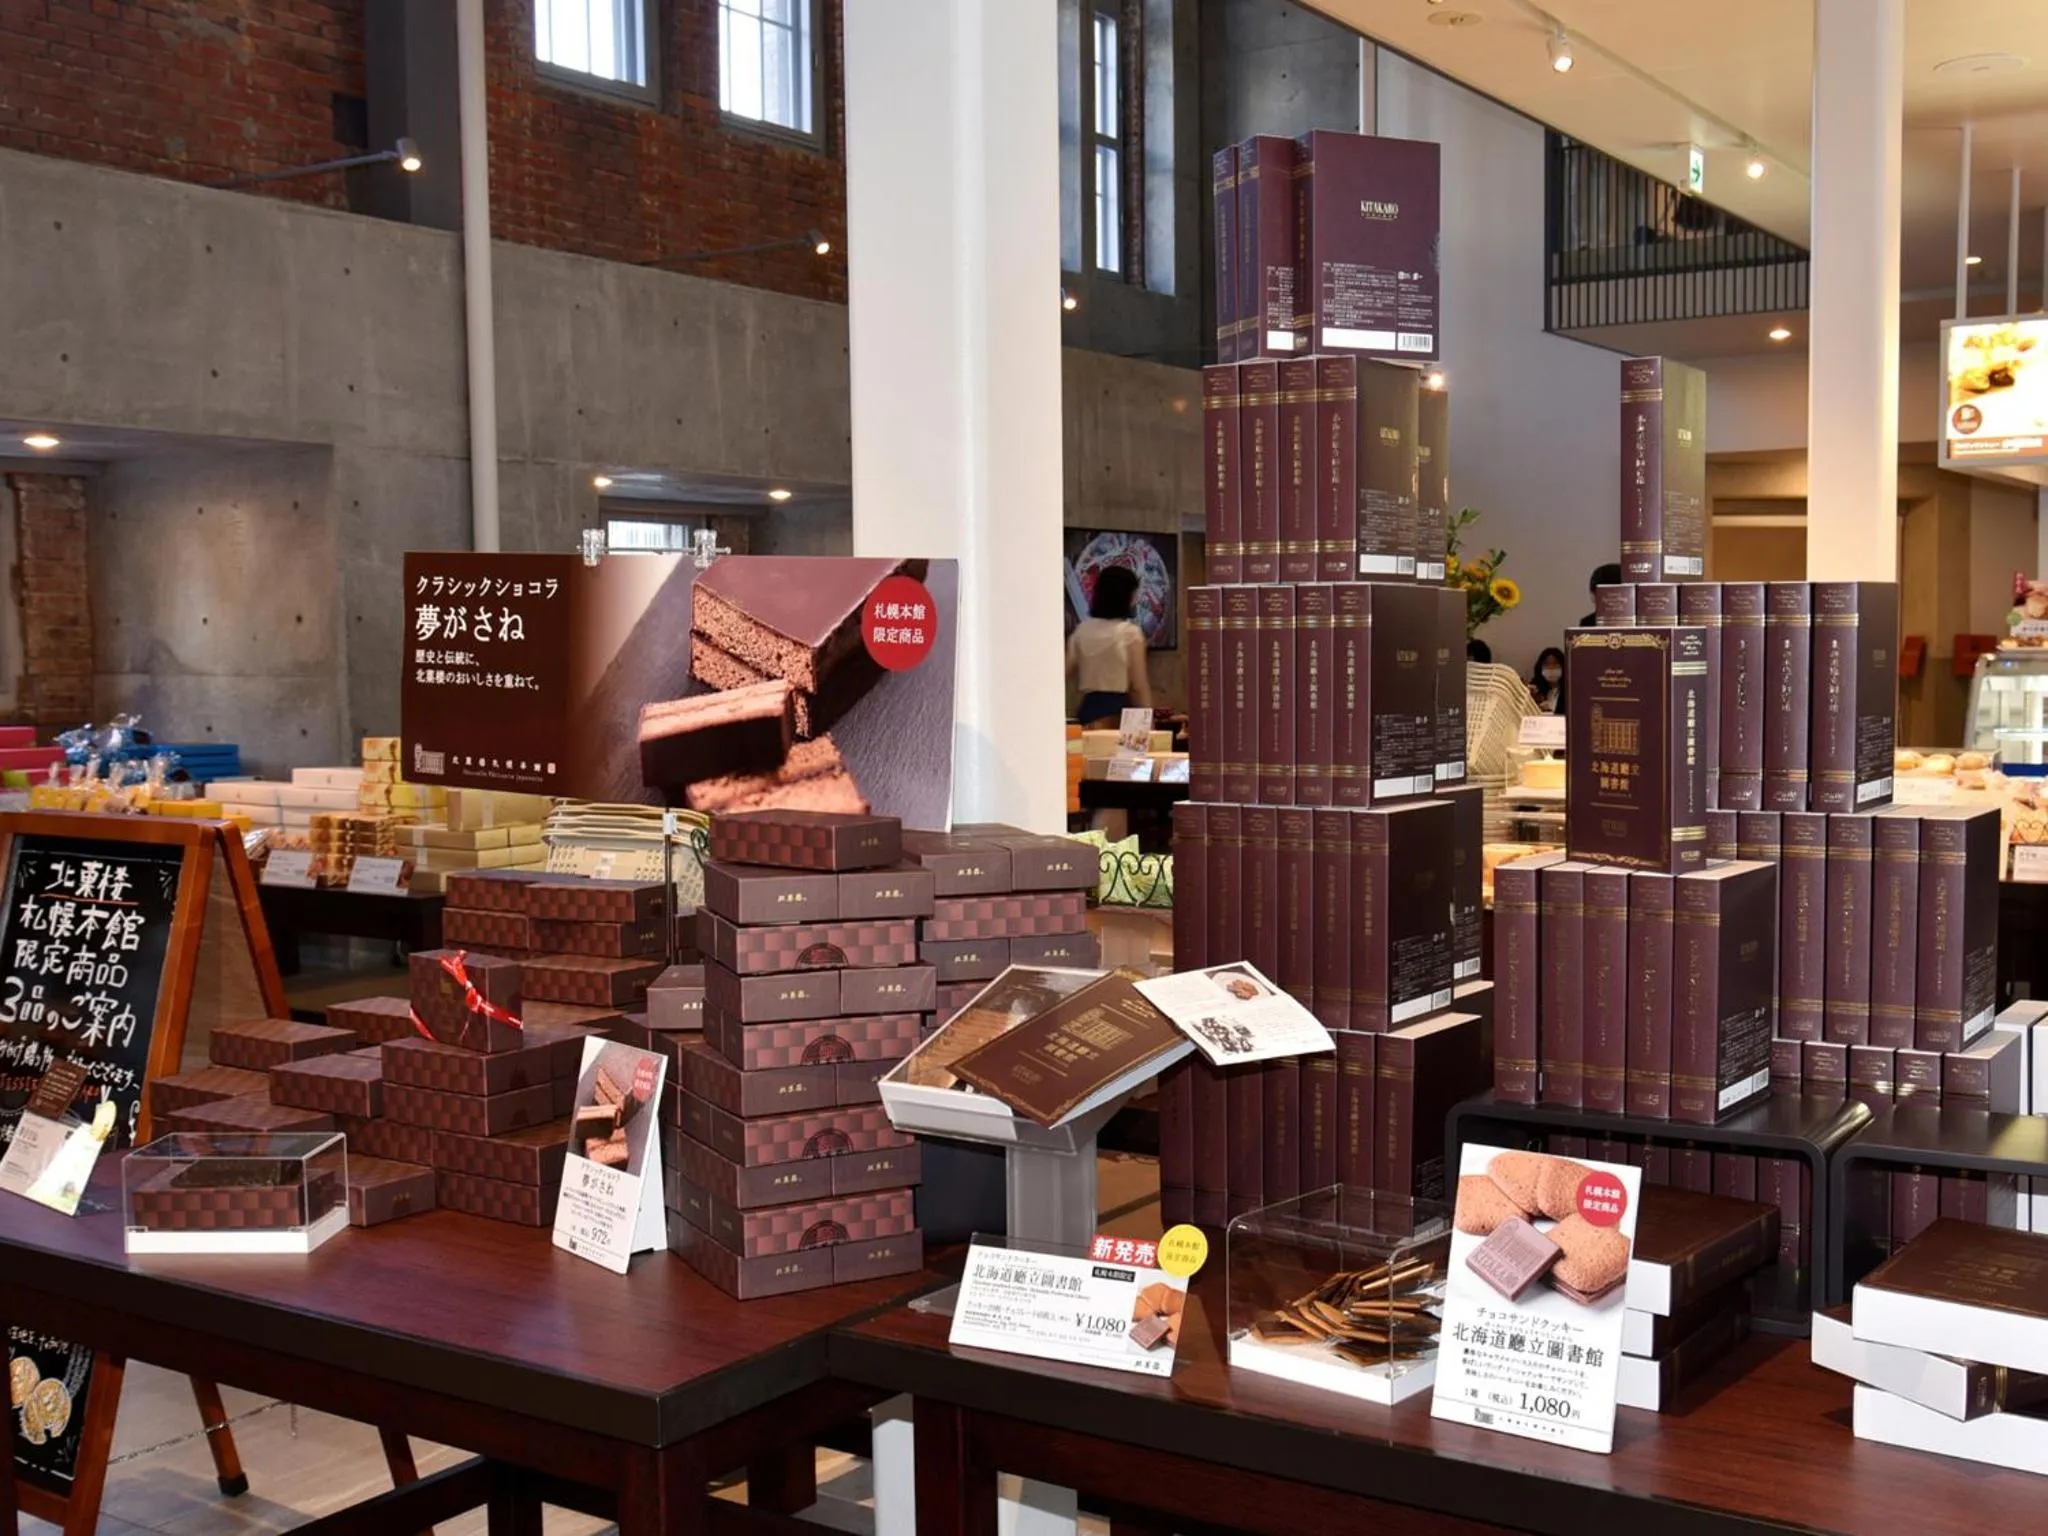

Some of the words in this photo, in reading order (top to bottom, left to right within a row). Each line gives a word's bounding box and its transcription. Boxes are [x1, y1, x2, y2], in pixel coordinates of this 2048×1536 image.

[1360, 200, 1399, 214] KITAKARO
[416, 575, 560, 599] クラシックショコラ
[415, 603, 526, 643] 夢がさね
[873, 602, 927, 621] 札幌本館
[872, 626, 925, 645] 限定商品
[415, 649, 480, 667] 歴史と伝統に、
[416, 668, 540, 691] 北菓楼のおいしさを重ねて。
[44, 860, 133, 901] 北菓楼
[18, 894, 146, 951] 札幌本館
[13, 938, 129, 988] 限定商品
[0, 975, 137, 1048] 3品のご案内
[1091, 1236, 1156, 1265] 新発売
[1475, 1305, 1586, 1335] チョコサンドクッキー
[1451, 1320, 1605, 1369] 北海道廳立圖書館
[1519, 1391, 1572, 1420] 1,080
